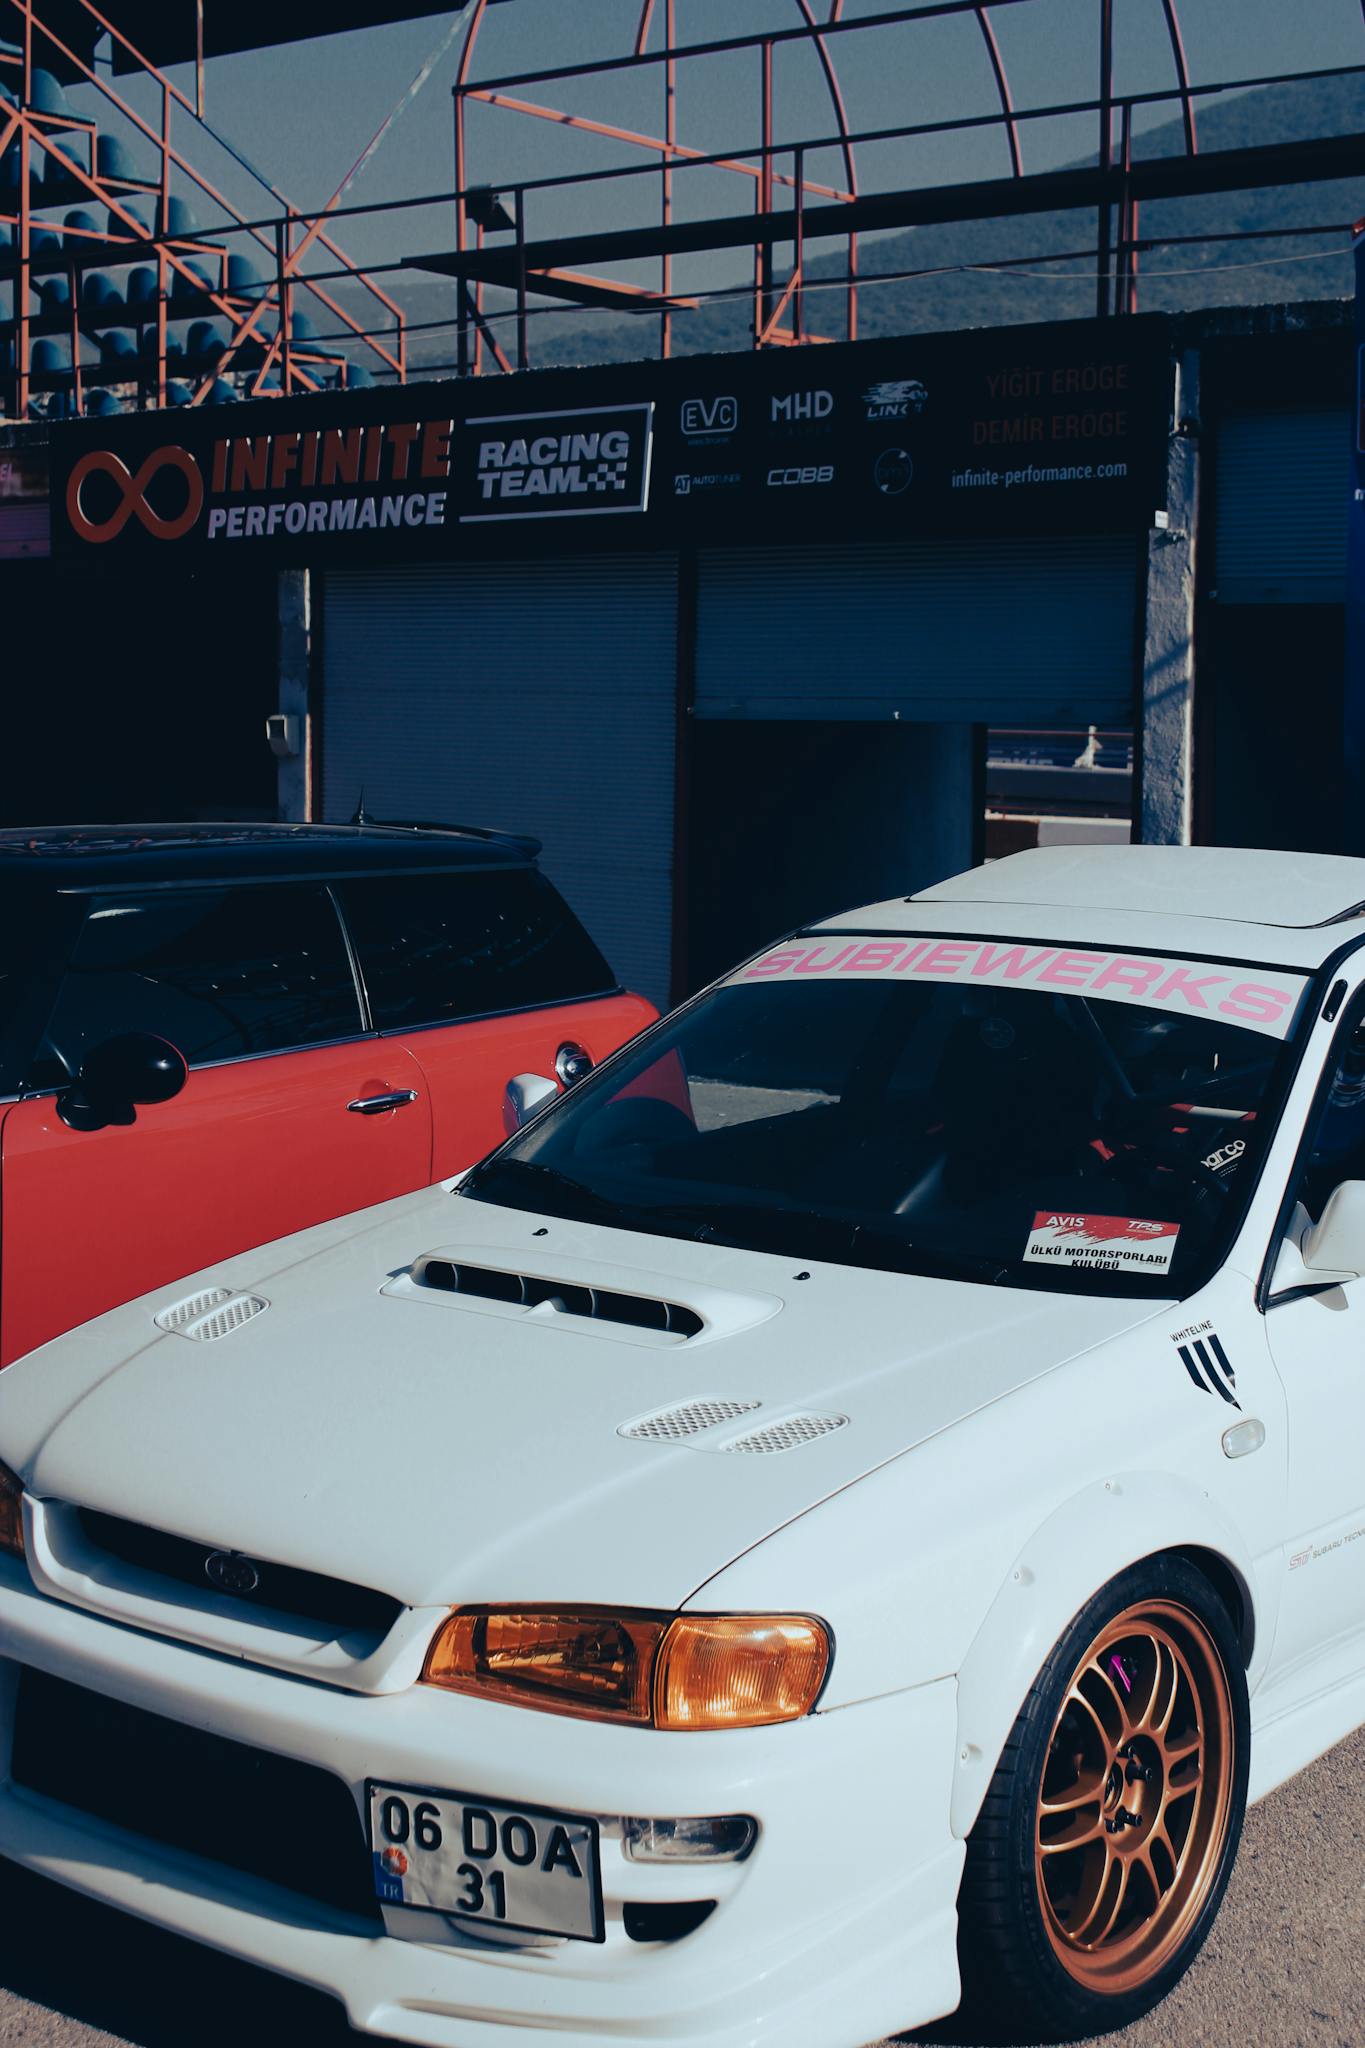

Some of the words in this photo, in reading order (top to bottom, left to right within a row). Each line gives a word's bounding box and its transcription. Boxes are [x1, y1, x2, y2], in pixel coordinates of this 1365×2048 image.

[683, 397, 736, 431] EVC
[771, 389, 834, 423] MHD
[866, 402, 909, 419] LINK
[972, 412, 1044, 447] DEMİR
[211, 418, 454, 493] INFINITE
[478, 430, 631, 470] RACING
[478, 465, 588, 500] TEAM
[766, 465, 835, 486] COBB
[951, 462, 1128, 489] infinite-performance.com
[207, 490, 447, 540] PERFORMANCE
[743, 940, 1293, 1025] SUBIEWERKS
[1046, 1216, 1086, 1228] AVIS
[1127, 1220, 1165, 1232] TPS
[1030, 1245, 1061, 1256] ÜLKÜ
[1064, 1247, 1168, 1264] MOTORSPORLARI
[1071, 1259, 1120, 1271] KULÜBÜ
[1170, 1319, 1214, 1343] WHITELINE
[1312, 1538, 1343, 1559] SUBARU
[382, 1795, 443, 1851] 06
[462, 1806, 583, 1879] DOA
[381, 1884, 401, 1899] TR
[456, 1862, 507, 1920] 31
